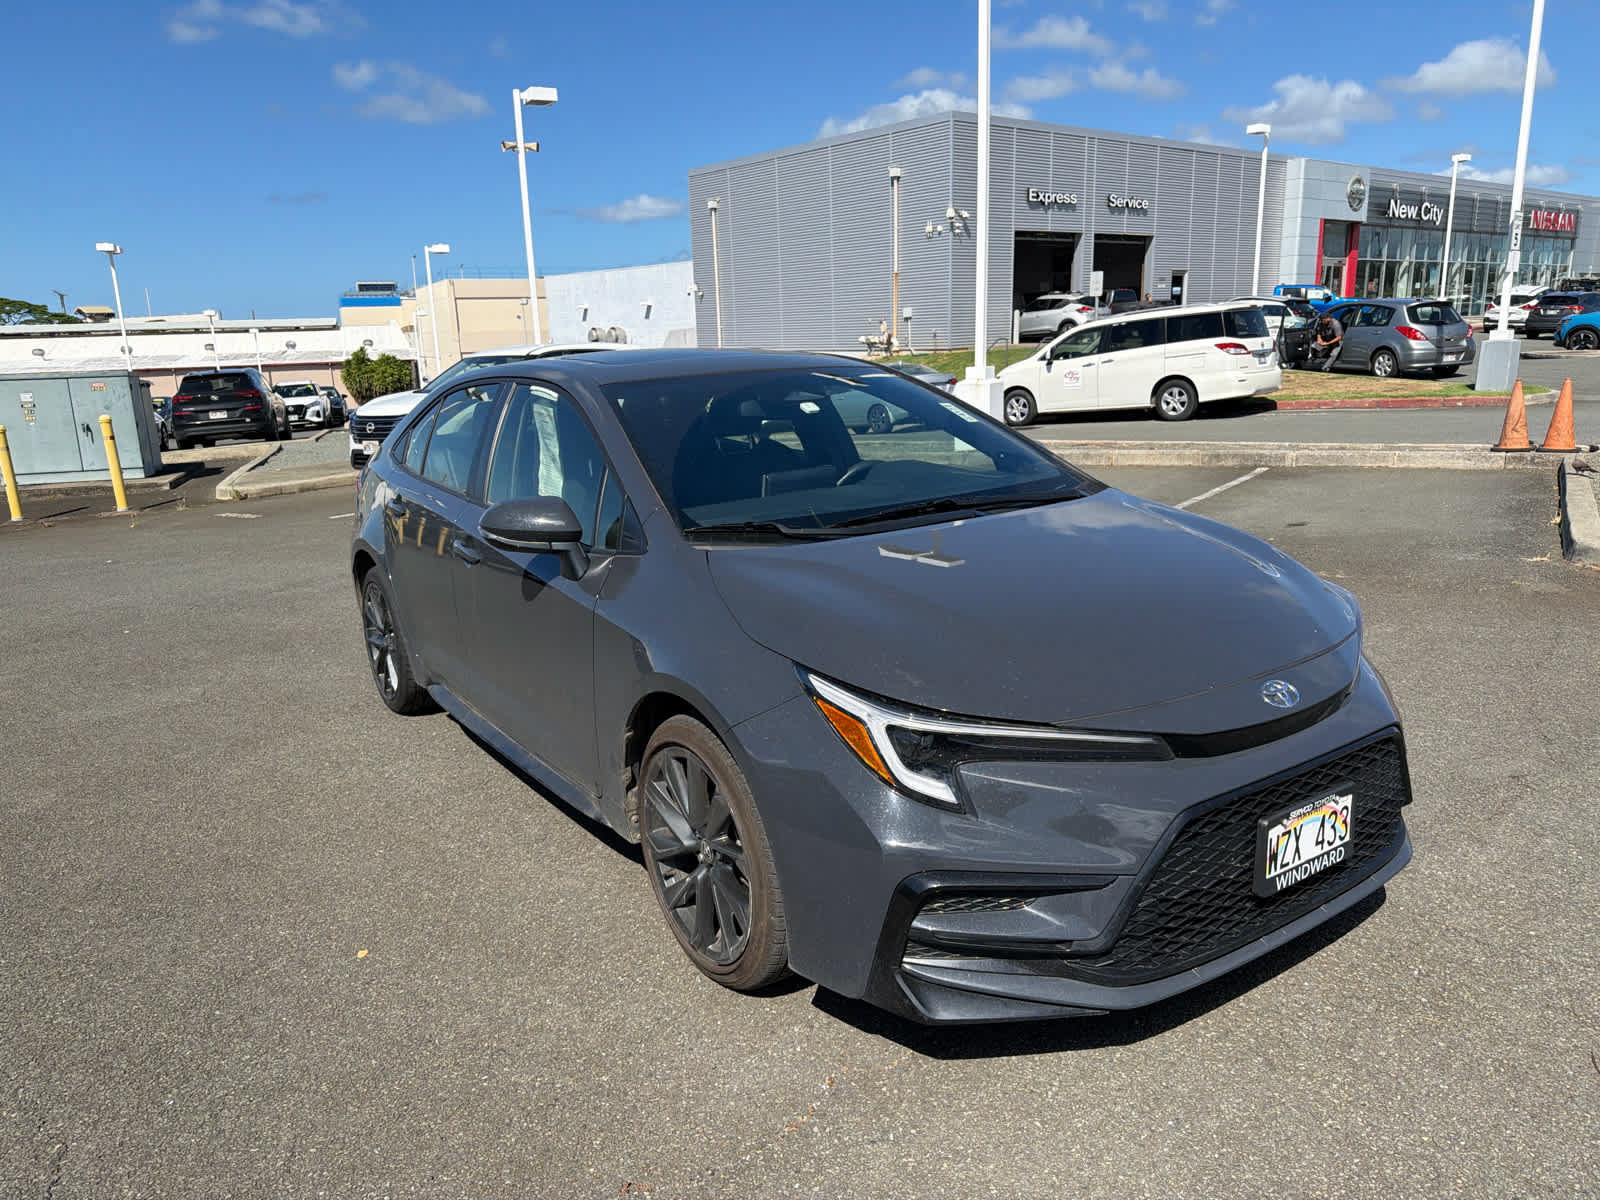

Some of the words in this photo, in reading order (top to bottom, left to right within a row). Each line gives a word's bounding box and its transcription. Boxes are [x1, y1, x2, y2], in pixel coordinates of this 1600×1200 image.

[1028, 188, 1078, 206] Express
[1109, 194, 1149, 209] Service
[1389, 199, 1418, 219] New
[1421, 202, 1443, 226] City
[1530, 210, 1576, 232] NISSAN
[1315, 805, 1349, 850] 433
[1276, 846, 1345, 891] WINDWARD
